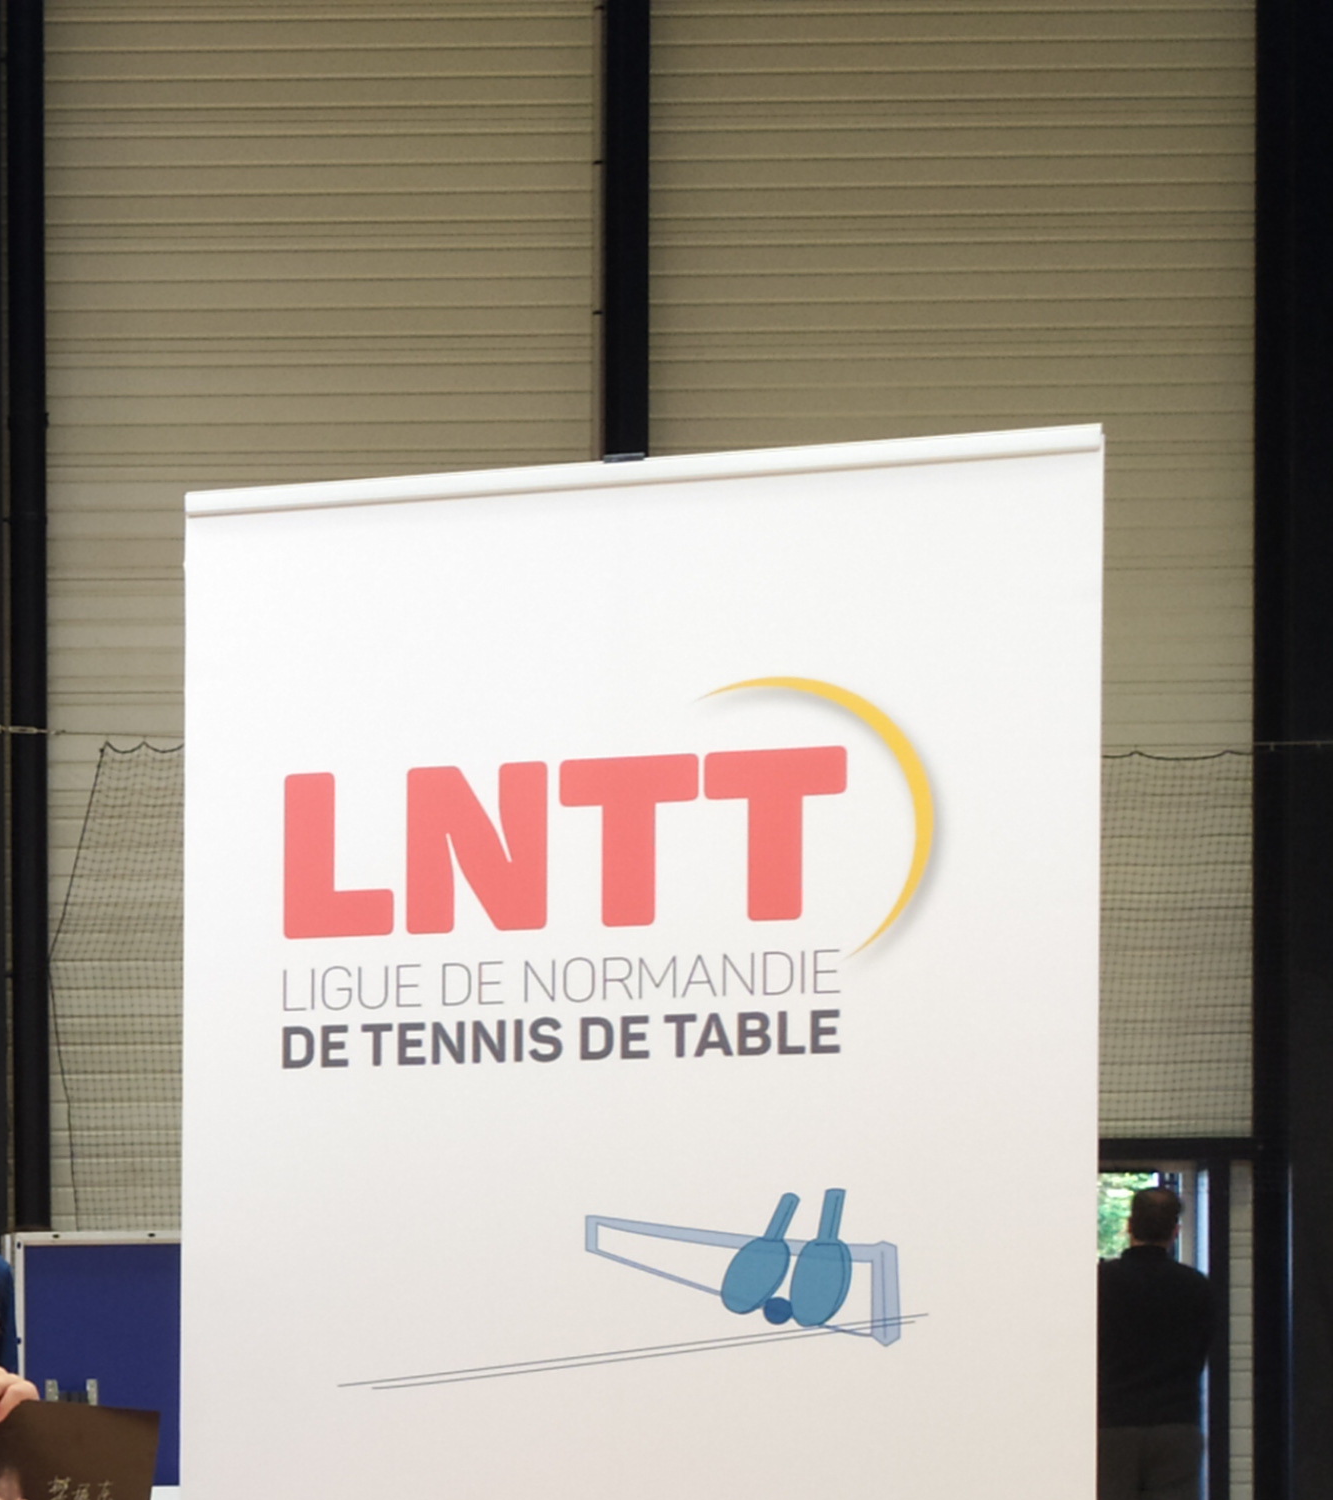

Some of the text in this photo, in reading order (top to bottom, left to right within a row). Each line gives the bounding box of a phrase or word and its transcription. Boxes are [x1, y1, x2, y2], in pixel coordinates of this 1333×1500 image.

[284, 745, 847, 940] LNTT
[282, 949, 841, 1012] LIGUE DE NORMANDIE
[282, 1009, 841, 1069] DE TENNIS DE TABLE
